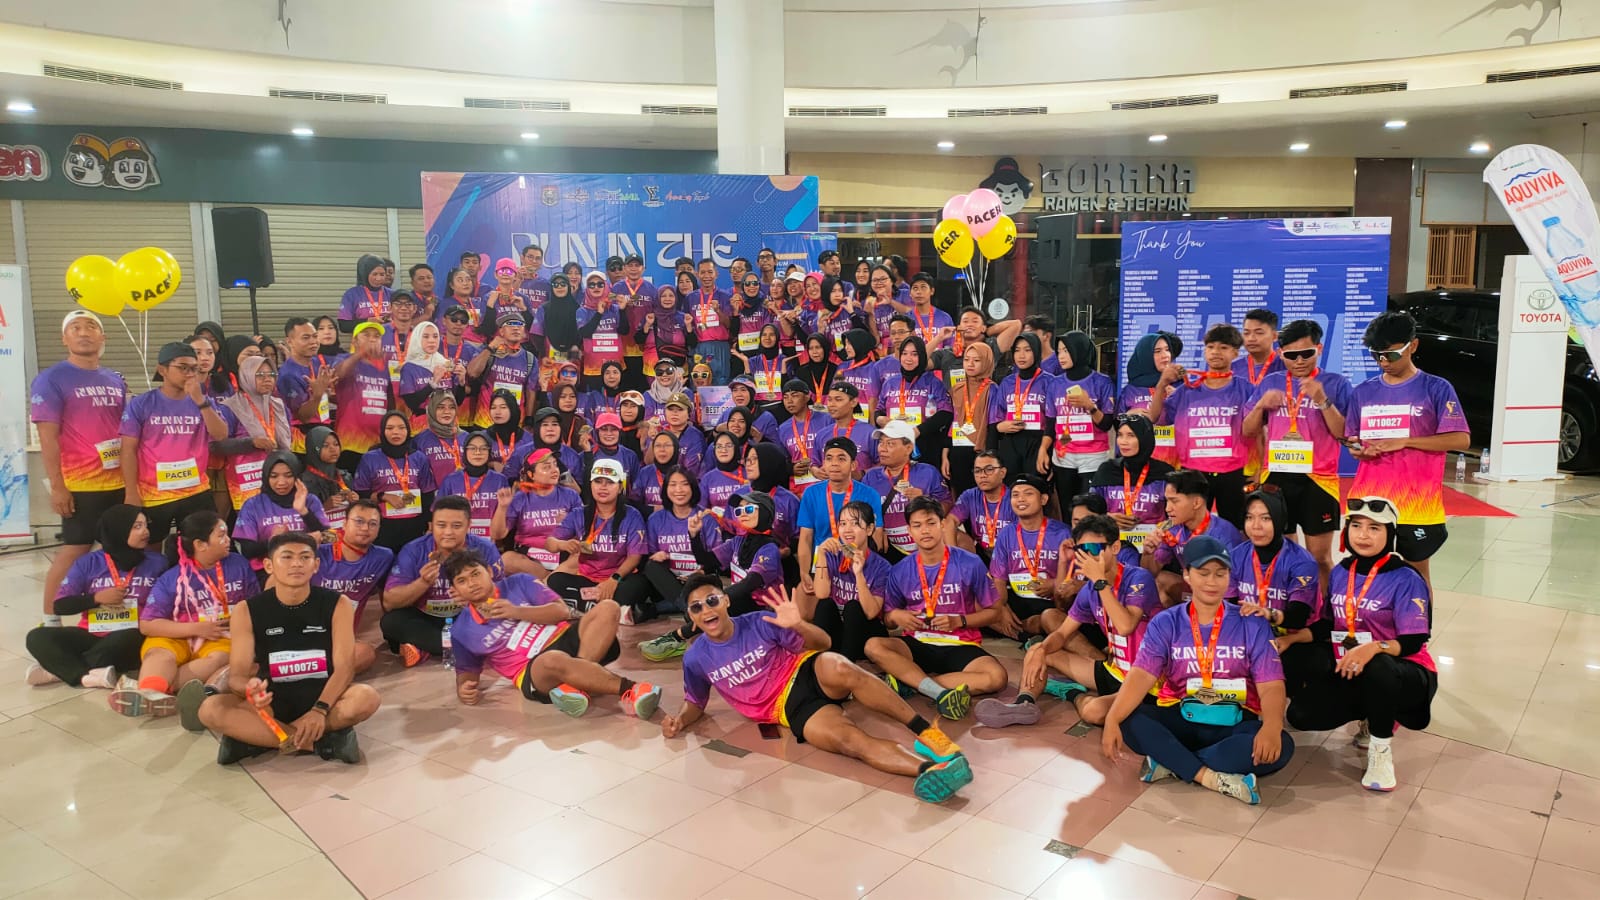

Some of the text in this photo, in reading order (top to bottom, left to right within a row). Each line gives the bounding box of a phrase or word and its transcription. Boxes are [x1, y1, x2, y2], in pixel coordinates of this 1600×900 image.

[1039, 162, 1195, 193] GOKANA
[1504, 171, 1565, 206] AQUVIVA
[1044, 196, 1190, 212] RAMEN & TEPPAN
[1131, 226, 1206, 260] Thank You
[1557, 257, 1593, 275] AQUVIVA
[1520, 313, 1562, 323] TOYOTA
[496, 373, 518, 383] MALL
[75, 387, 95, 397] RUN
[107, 386, 122, 397] THE
[92, 397, 118, 407] MALL
[1188, 406, 1239, 417] RUN IN THE
[150, 416, 172, 424] RUN
[1197, 418, 1229, 426] MALL
[1367, 418, 1402, 427] W10027
[163, 425, 194, 434] MALL
[1274, 453, 1305, 462] W20174
[165, 471, 192, 479] PACER
[1140, 493, 1159, 503] THE
[523, 509, 540, 520] RUN
[533, 518, 562, 527] MALL
[658, 535, 676, 544] RUN
[592, 543, 617, 552] MALL
[1041, 550, 1058, 560] THE
[133, 577, 155, 587] THE
[1267, 588, 1288, 600] THE
[1171, 646, 1245, 659] RUN THE
[278, 661, 318, 675] W10075
[709, 646, 767, 684] RUN IN THE
[728, 666, 762, 688] MALL
